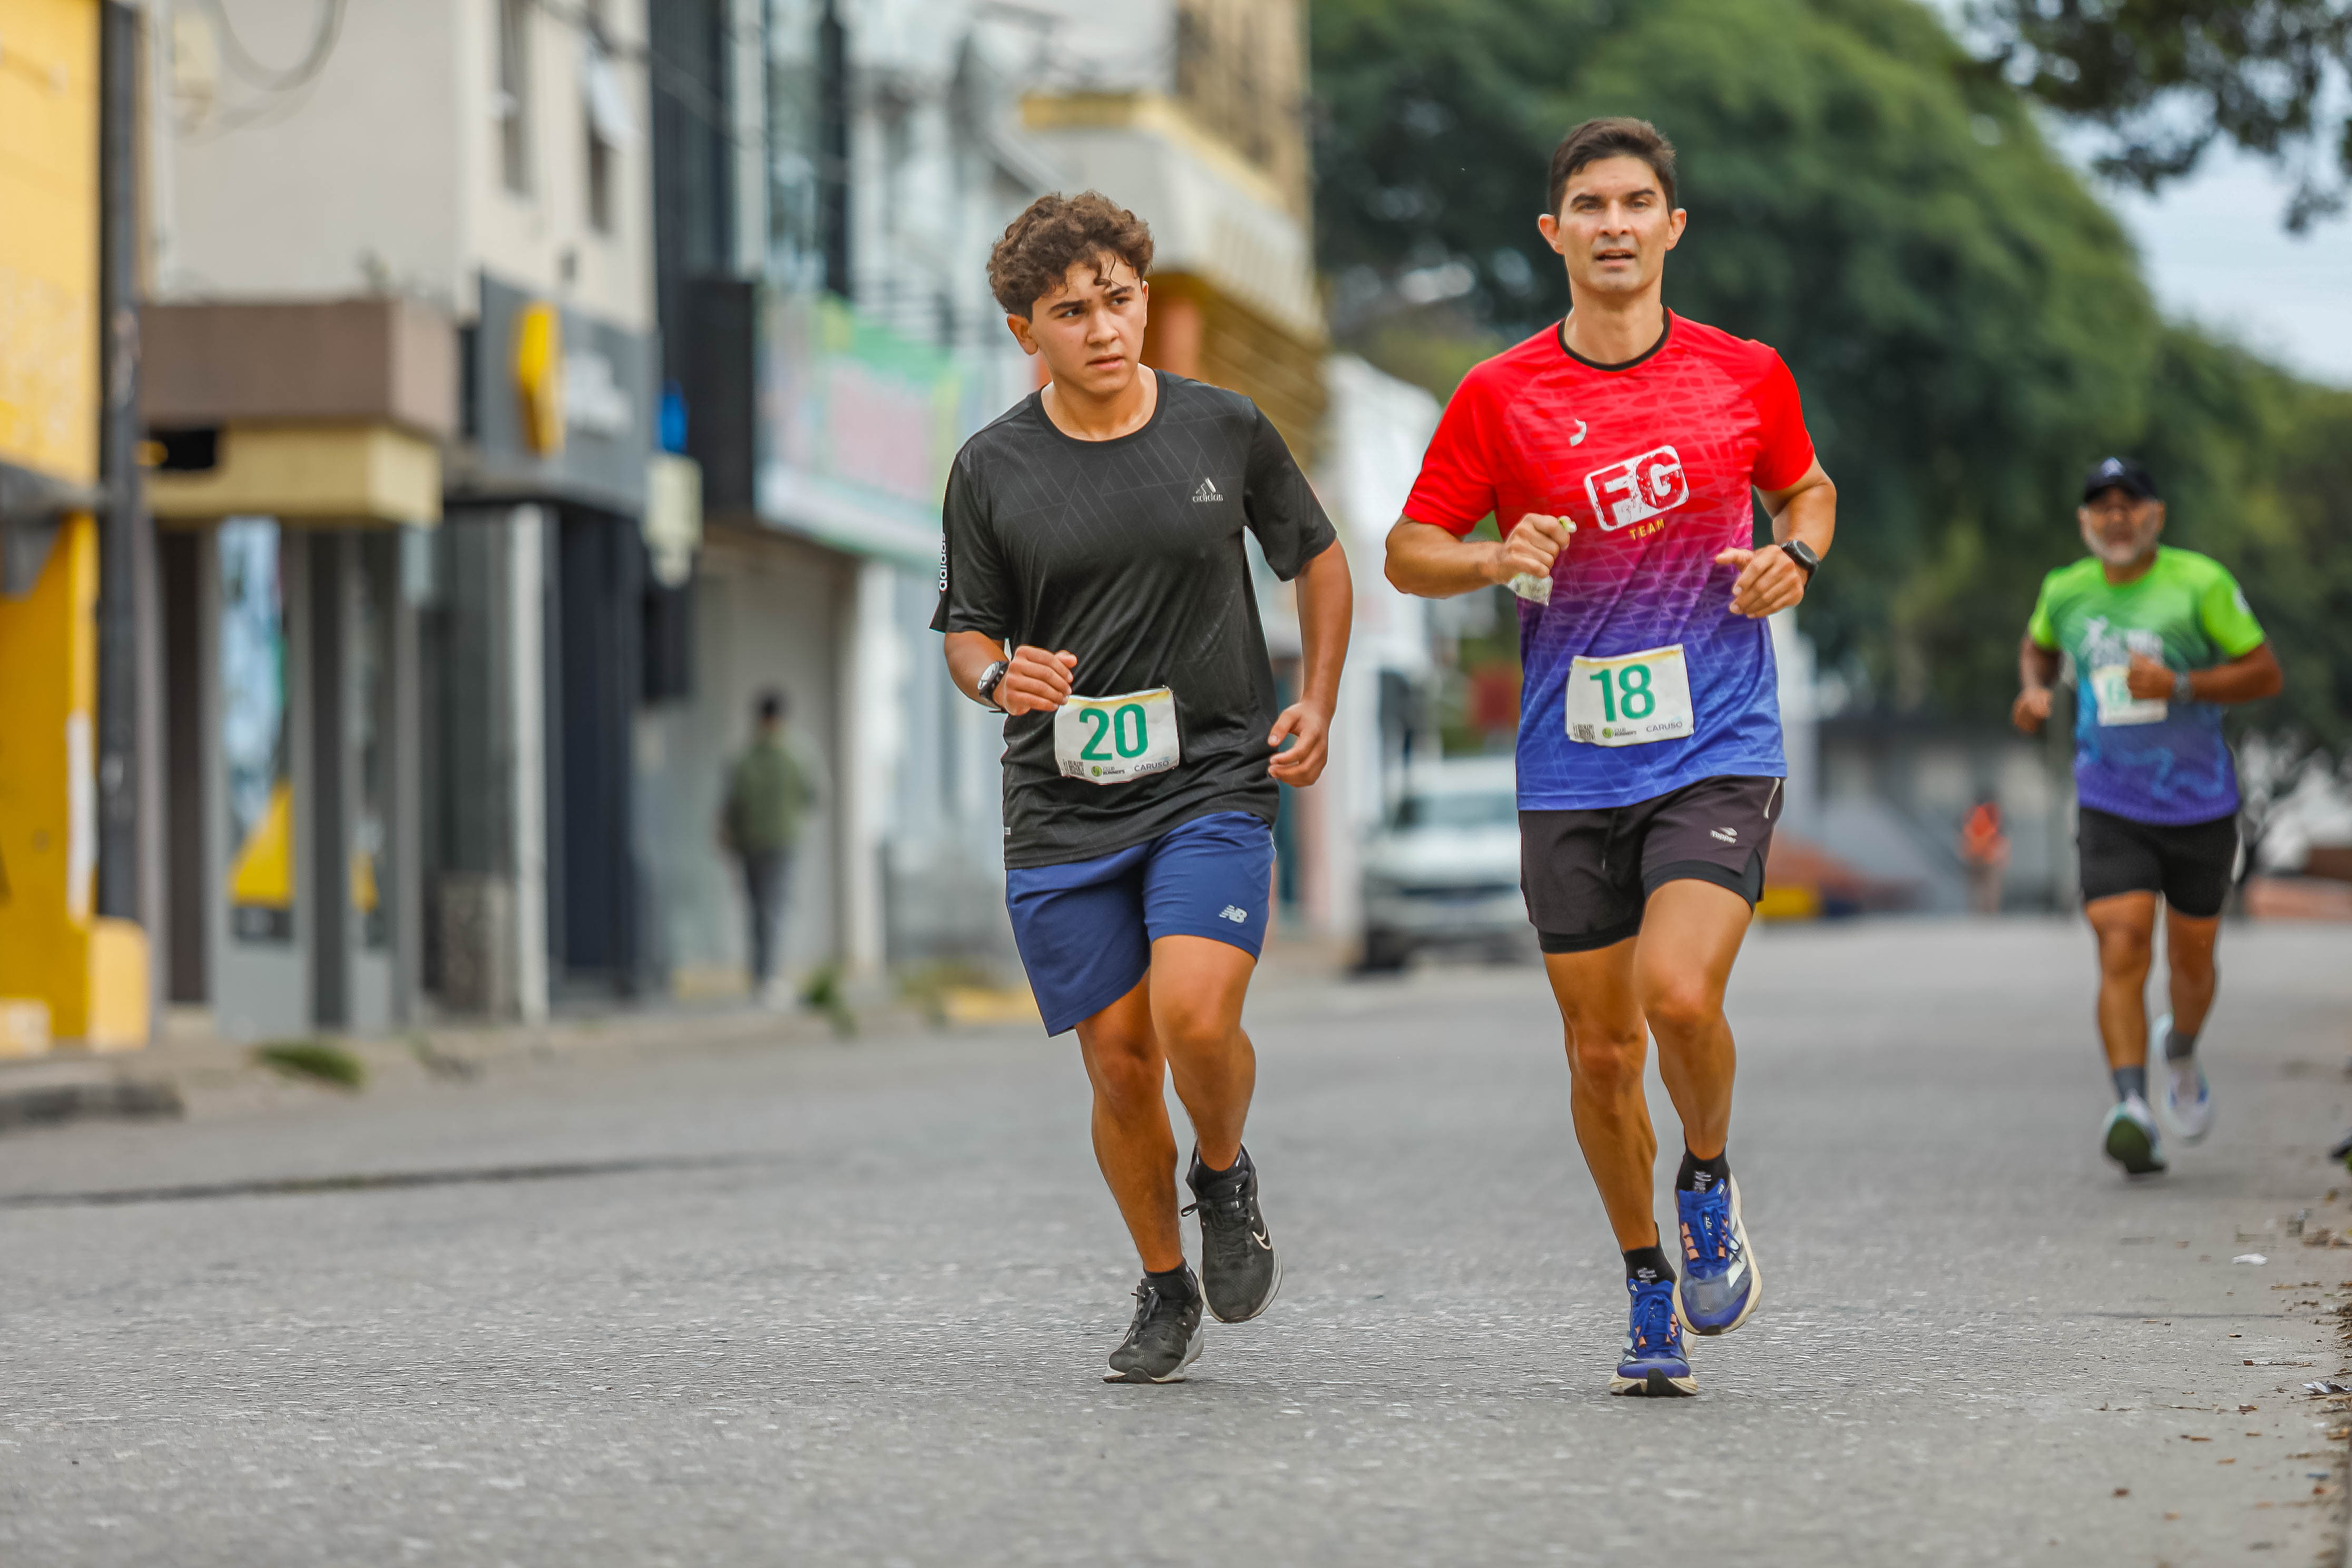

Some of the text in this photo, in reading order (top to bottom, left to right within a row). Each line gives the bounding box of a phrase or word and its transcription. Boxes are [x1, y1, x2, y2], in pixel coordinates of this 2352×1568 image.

[1193, 492, 1223, 502] adidas
[1629, 518, 1665, 541] TEAM
[1589, 664, 1656, 722] 18
[1080, 703, 1149, 760] 20
[1646, 721, 1683, 732] CARUSO
[1134, 760, 1169, 772] CARUSO
